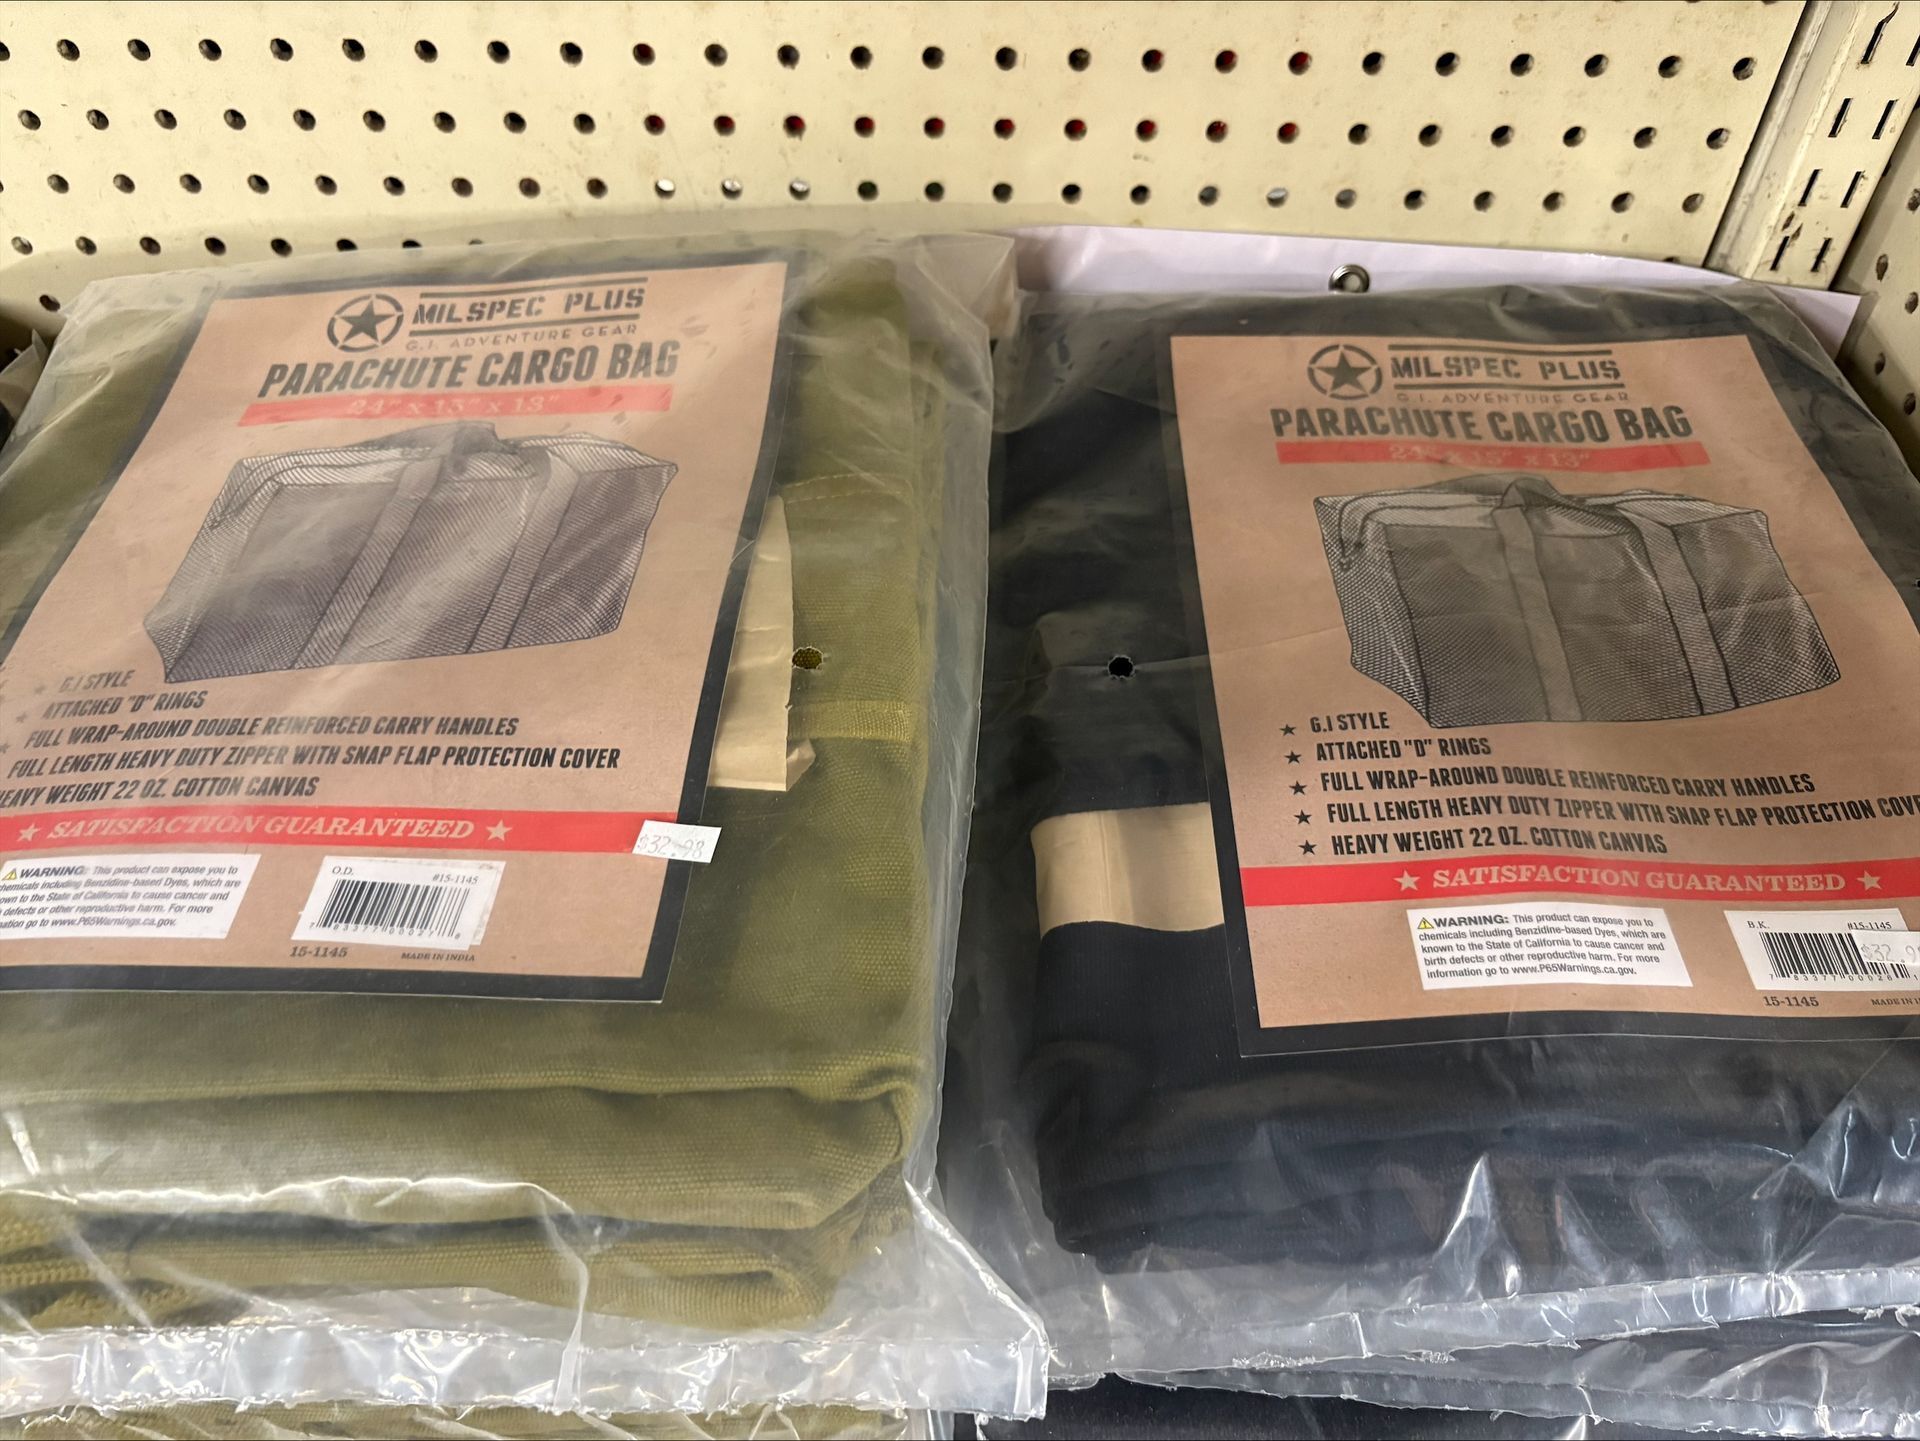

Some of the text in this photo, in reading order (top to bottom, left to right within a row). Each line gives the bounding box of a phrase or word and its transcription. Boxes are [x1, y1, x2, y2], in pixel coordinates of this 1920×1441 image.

[411, 287, 646, 326] MILSPEC PLUS
[448, 328, 573, 350] ADVENTURE
[581, 323, 638, 340] GEAR
[256, 339, 682, 399] PARACHUTE CARGO BAG
[1390, 355, 1621, 381] MILSPEC PLUS
[1441, 392, 1563, 406] ADVENTURE
[1572, 391, 1630, 404] GEAR
[1269, 405, 1694, 444] PARACHUTE CARGO BAG
[84, 669, 136, 691] STYLE
[42, 690, 208, 719] ATTACHED "D" RINGS
[24, 715, 520, 749] FULL WRAP-AROUND DOUBLE REINFORCED CARRY HANDLES
[1310, 711, 1391, 733] G.I STYLE
[1316, 737, 1492, 762] ATTACHED "D" RINGS
[7, 744, 622, 779] FULL LENGTH HEAVY DUTY ZIPPER WITH SNAP FLAP PROTECTION COVER
[45, 781, 116, 805] WEIGHT
[111, 780, 139, 800] 22
[139, 778, 166, 799] OZ.
[171, 777, 246, 798] COTTON
[244, 776, 320, 797] CANVAS
[1320, 766, 1816, 797] FULL WRAP-AROUND DOUBLE REINFORCED CARRY HANDLES
[1326, 802, 1371, 823] FULL
[1375, 798, 1444, 821] LENGTH
[1448, 795, 1503, 818] HEAVY
[1506, 795, 1552, 817] DUTY
[1556, 799, 1618, 821] ZIPPER
[1616, 801, 1666, 824] WITH
[1668, 806, 1711, 826] SNAP
[1713, 807, 1758, 827] FLAP
[1760, 799, 1877, 825] PROTECTION
[47, 814, 475, 840] SATISFACTION GUARANTEED
[1331, 826, 1668, 855] HEAVY WEIGHT 22 OZ. COTTON CANVAS
[331, 866, 355, 876] O.D.
[431, 872, 480, 885] #15-1145
[1432, 864, 1846, 892] SATISFACTION GUARANTEED
[1432, 912, 1654, 928] WARNING: This product can expose you to
[1746, 920, 1771, 930] B.K.
[1418, 930, 1467, 942] chemicals
[1469, 927, 1513, 939] including
[1514, 924, 1593, 936] Benzidine-based
[1621, 929, 1649, 939] which
[1650, 930, 1667, 940] are
[289, 946, 349, 959] 15-1145
[1420, 937, 1666, 954] known to the State of California to cause cancer and
[1861, 943, 1920, 963] $32.9
[400, 951, 476, 963] MADE IN INDIA
[1423, 956, 1447, 967] birth
[1449, 954, 1485, 965] defects
[1487, 954, 1497, 963] or
[1499, 952, 1525, 962] other
[1527, 950, 1587, 963] reproductive
[1617, 952, 1633, 963] For
[1635, 954, 1661, 963] more
[1426, 967, 1483, 979] information
[1485, 968, 1498, 978] go
[1499, 966, 1509, 975] to
[1762, 995, 1820, 1007] 15-1145
[1870, 998, 1901, 1006] MADE
